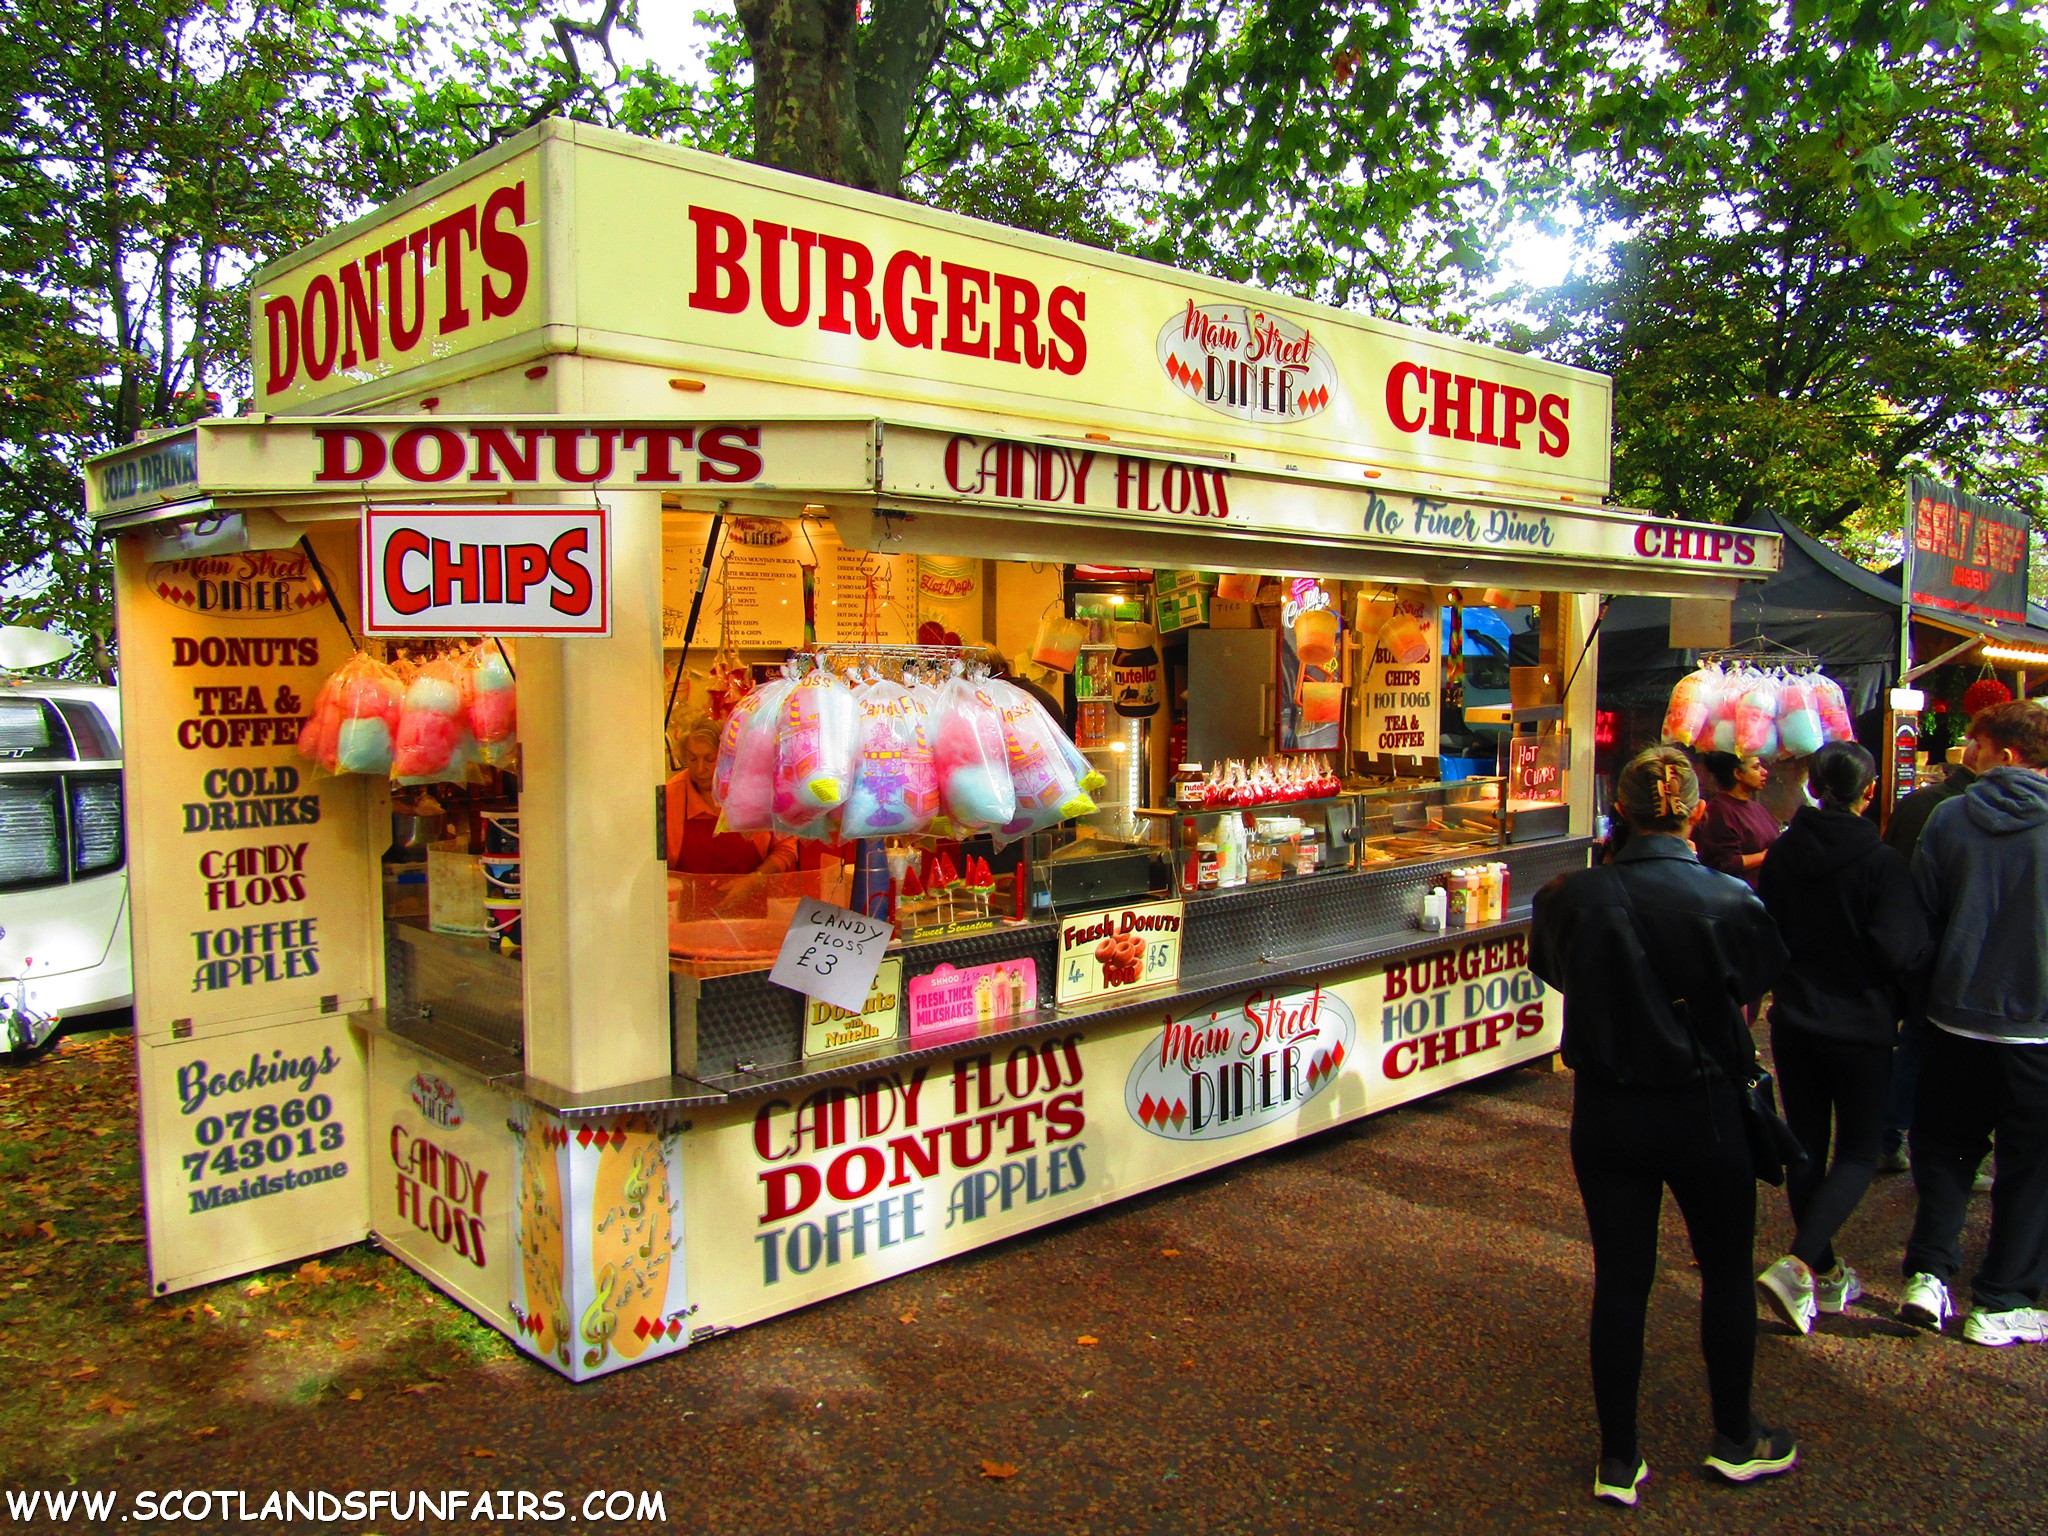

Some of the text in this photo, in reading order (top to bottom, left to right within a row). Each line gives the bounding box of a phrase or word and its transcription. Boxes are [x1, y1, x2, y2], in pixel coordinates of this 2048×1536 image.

[264, 181, 529, 396] DONUTS
[688, 204, 1087, 376] BURGERS
[1184, 298, 1317, 366] Main Street
[1206, 354, 1295, 417] DINER
[1385, 361, 1570, 459] CHIPS
[313, 425, 763, 484] DONUTS
[945, 434, 1231, 518] CANDY FLOSS
[1363, 489, 1555, 548] No Finer Diner
[1634, 523, 1756, 566] CHIPS
[236, 552, 311, 580] Street
[384, 527, 594, 616] CHIPS
[196, 579, 293, 612] DINER
[172, 636, 320, 668] DONUTS
[1114, 665, 1157, 686] nutella
[1385, 670, 1420, 686] CHIPS
[194, 684, 302, 717] TEA &
[1374, 691, 1431, 708] HOT DOGS
[1385, 714, 1419, 731] TEA &
[1379, 731, 1424, 749] COFFEE
[203, 765, 300, 800] COLD
[182, 794, 321, 834] DRINKS
[199, 842, 310, 880] CANDY
[204, 873, 307, 912] FLOSS
[190, 917, 319, 962] TOFFEE
[810, 910, 884, 942] CANDY
[814, 931, 864, 956] FLOSS
[912, 921, 994, 939] Sweet Sensation
[191, 947, 321, 993] APPLES
[948, 985, 973, 1003] THICK
[1383, 932, 1531, 1003] BURGER
[825, 1023, 879, 1048] Nutella
[916, 1001, 974, 1027] MILKSHAKES
[1161, 982, 1328, 1072] Main Street
[1381, 990, 1451, 1044] HOT
[1382, 1001, 1545, 1080] CHIPS
[177, 1045, 341, 1116] Bookings
[752, 1031, 1086, 1162] CANDY FLOSS
[1189, 1045, 1304, 1135] DINER
[195, 1093, 333, 1146] 07860
[182, 1121, 345, 1182] 743013
[390, 1123, 490, 1217] CANDY
[757, 1089, 1087, 1225] DONUTS
[189, 1160, 348, 1215] Maidstone
[395, 1172, 487, 1269] FLOSS
[754, 1142, 1088, 1287] TOFFEE APPLES
